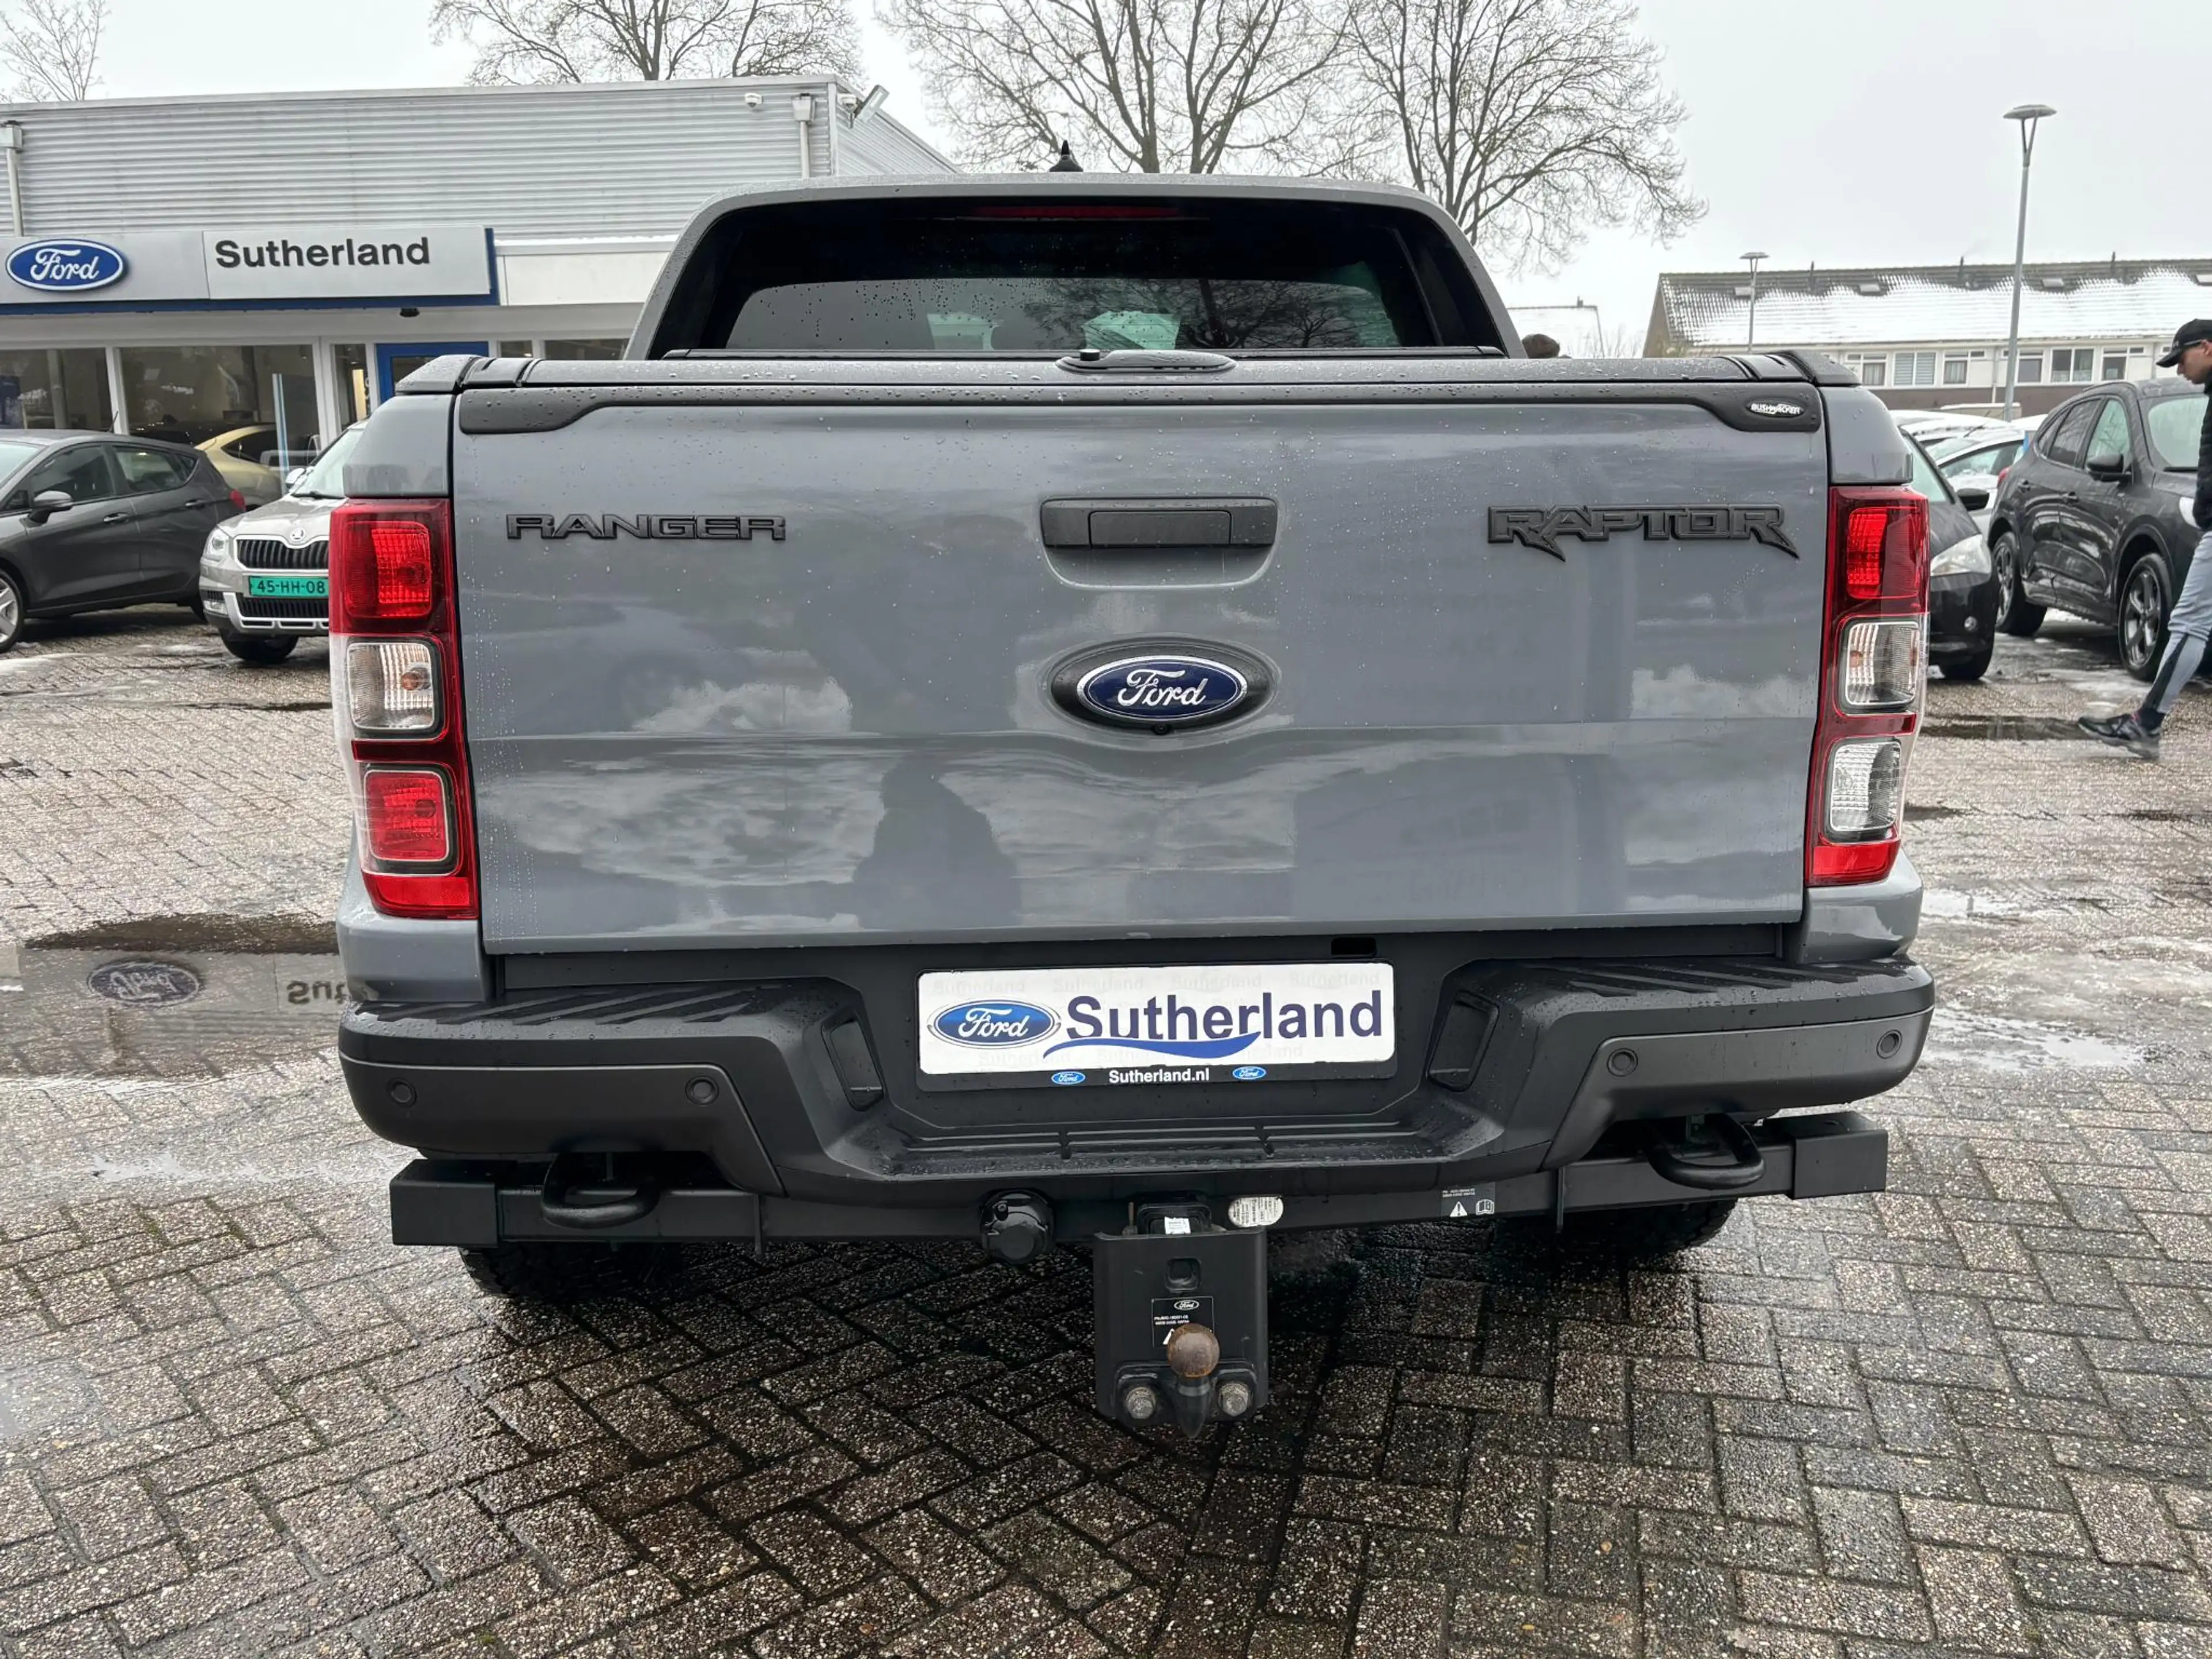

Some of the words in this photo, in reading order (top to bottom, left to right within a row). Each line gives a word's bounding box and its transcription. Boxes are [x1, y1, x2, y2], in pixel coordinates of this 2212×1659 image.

[30, 248, 100, 282] Ford
[216, 236, 430, 269] Sutherland
[505, 513, 787, 541] RANGER
[1487, 503, 1800, 562] RAPTOR
[257, 579, 327, 594] 45-HH-08
[1117, 668, 1209, 707] Ford
[957, 1007, 1030, 1037] Ford
[1066, 990, 1382, 1041] Sutherland
[1108, 1067, 1210, 1084] Sutherland.nl
